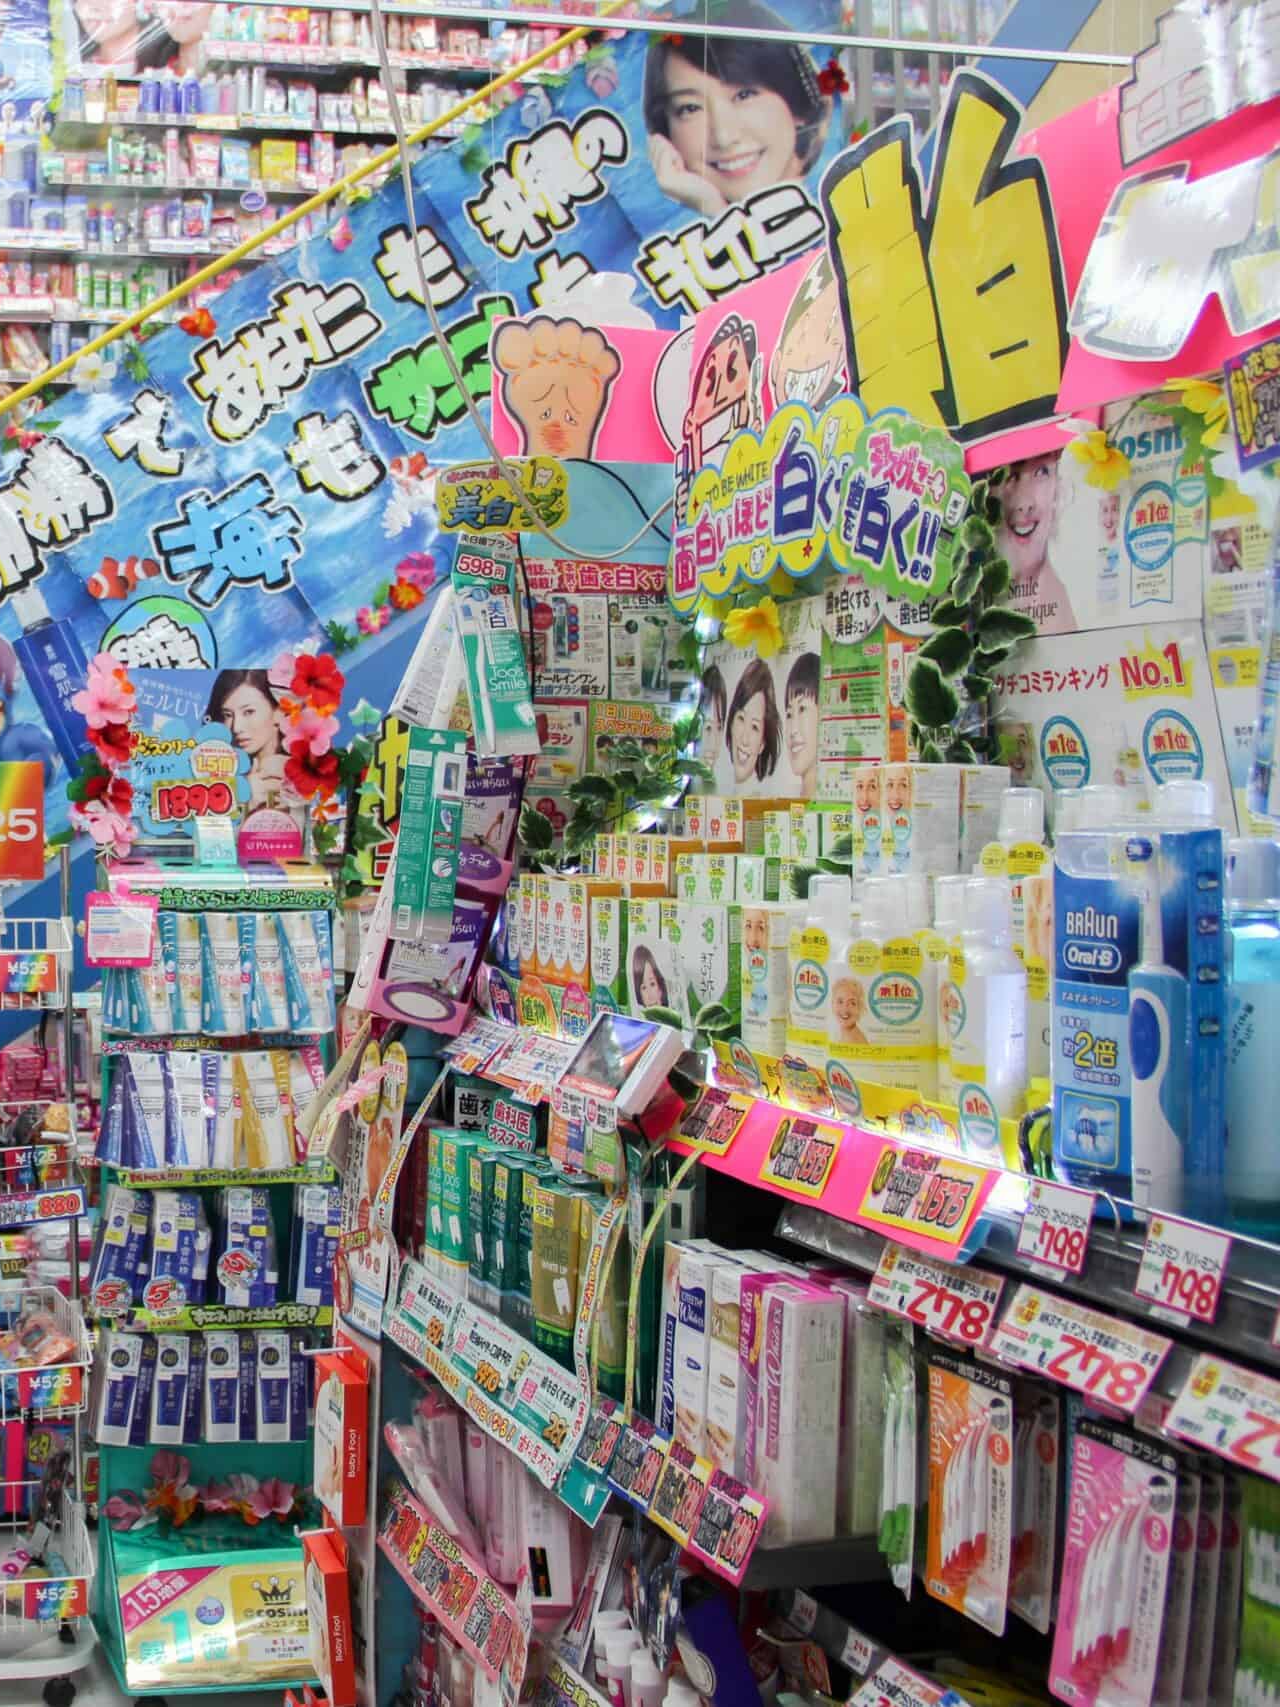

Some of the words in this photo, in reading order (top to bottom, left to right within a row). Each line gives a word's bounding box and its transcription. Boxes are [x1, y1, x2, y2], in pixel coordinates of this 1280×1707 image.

[706, 486, 720, 503] TO
[721, 476, 735, 493] BE
[735, 461, 769, 488] WHITE
[443, 485, 514, 530] 美白
[457, 555, 506, 580] 598円
[489, 679, 528, 691] Smile
[994, 662, 1110, 697] クチコミランキング
[1119, 641, 1186, 690] No.1
[1066, 905, 1118, 939] BRAUN
[7, 960, 49, 976] ¥525
[1067, 946, 1113, 966] Oral-B
[493, 1101, 533, 1134] 歯科医
[15, 1150, 58, 1165] ¥25
[38, 1193, 81, 1217] 880
[920, 1173, 973, 1227] 1575
[1038, 1220, 1086, 1269] 798
[1160, 1259, 1218, 1317] 798
[905, 1278, 990, 1340] 278
[28, 1375, 73, 1390] ¥525
[1046, 1333, 1146, 1405] 278
[1230, 1409, 1280, 1466] 2
[347, 1450, 358, 1480] Baby
[1150, 1519, 1161, 1539] 8
[35, 1585, 79, 1601] ¥525
